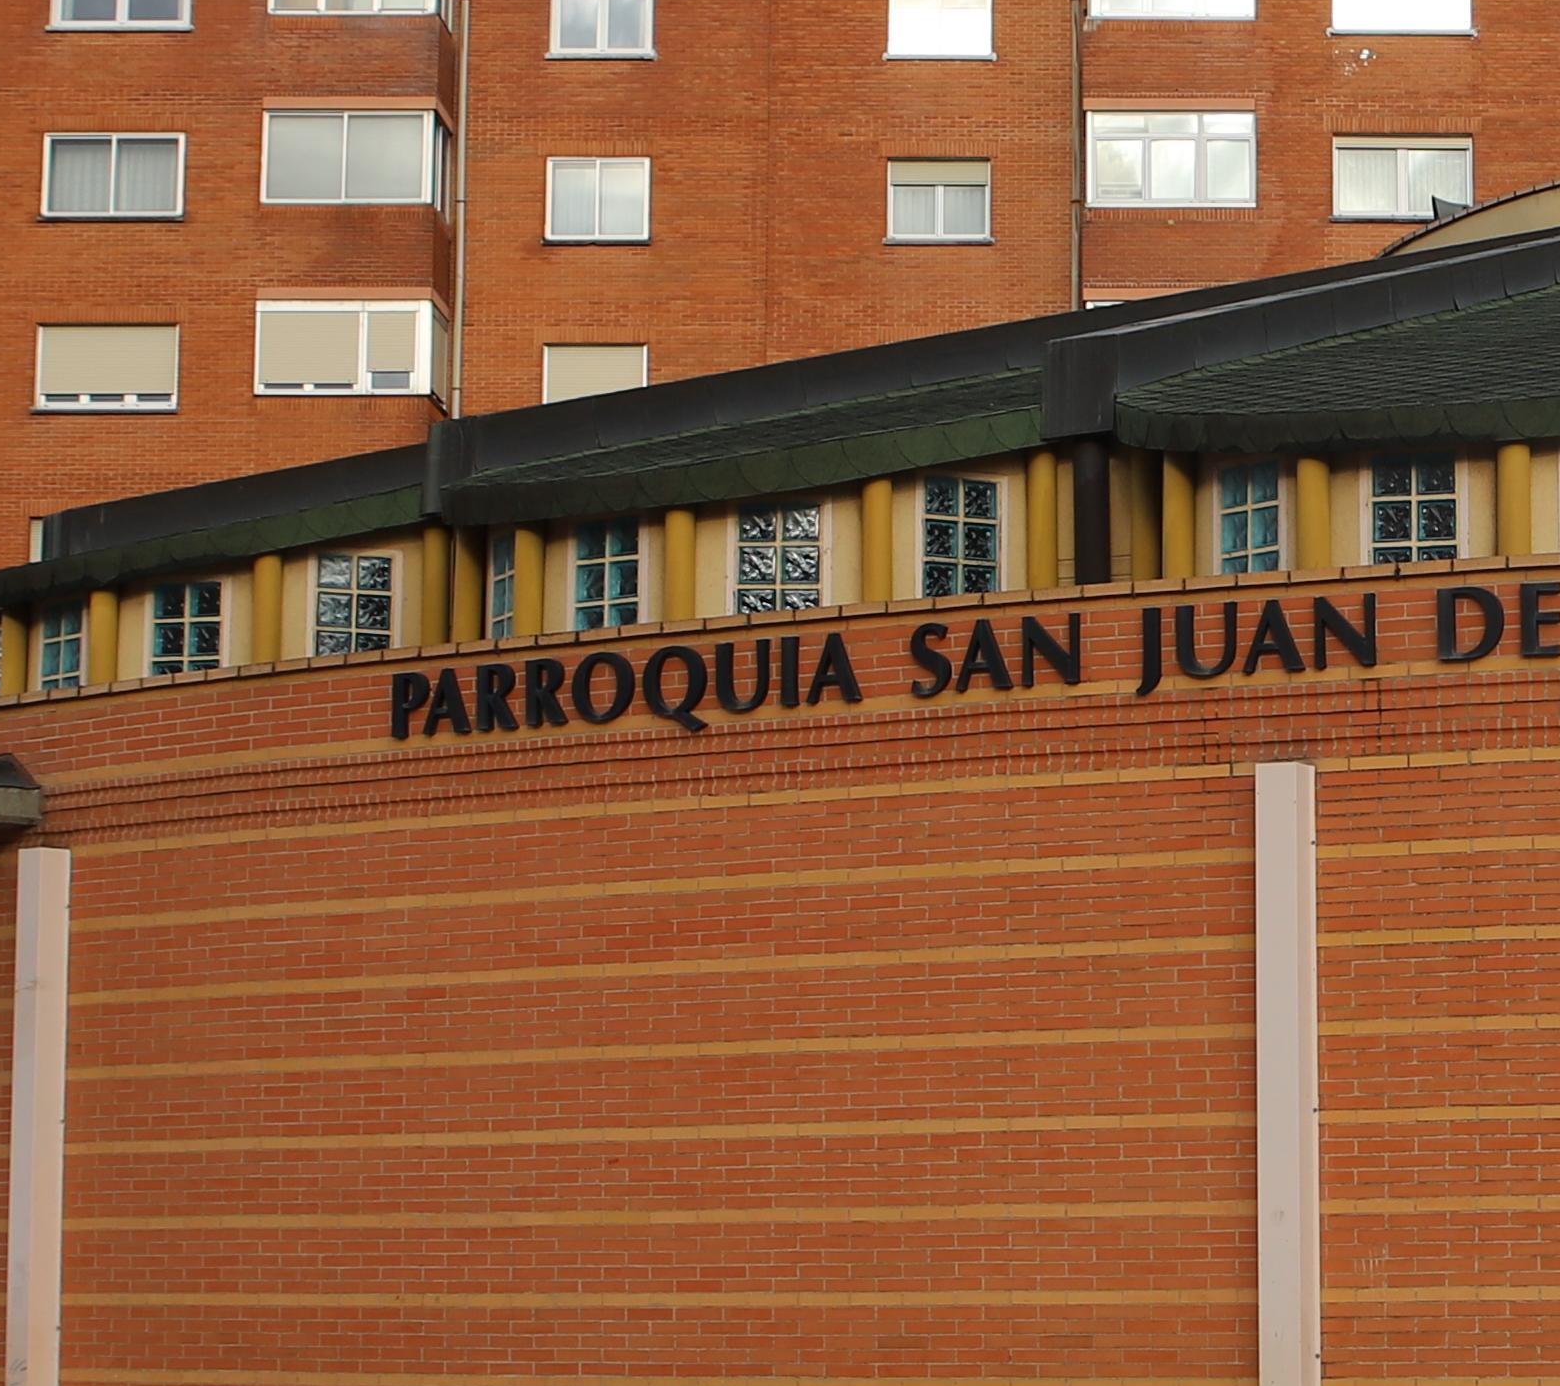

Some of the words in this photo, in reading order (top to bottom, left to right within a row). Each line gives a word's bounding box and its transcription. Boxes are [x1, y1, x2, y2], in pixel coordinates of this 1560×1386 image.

[390, 631, 864, 740] PARROQUIA
[909, 612, 1081, 699] SAN
[1135, 592, 1378, 698] JUAN
